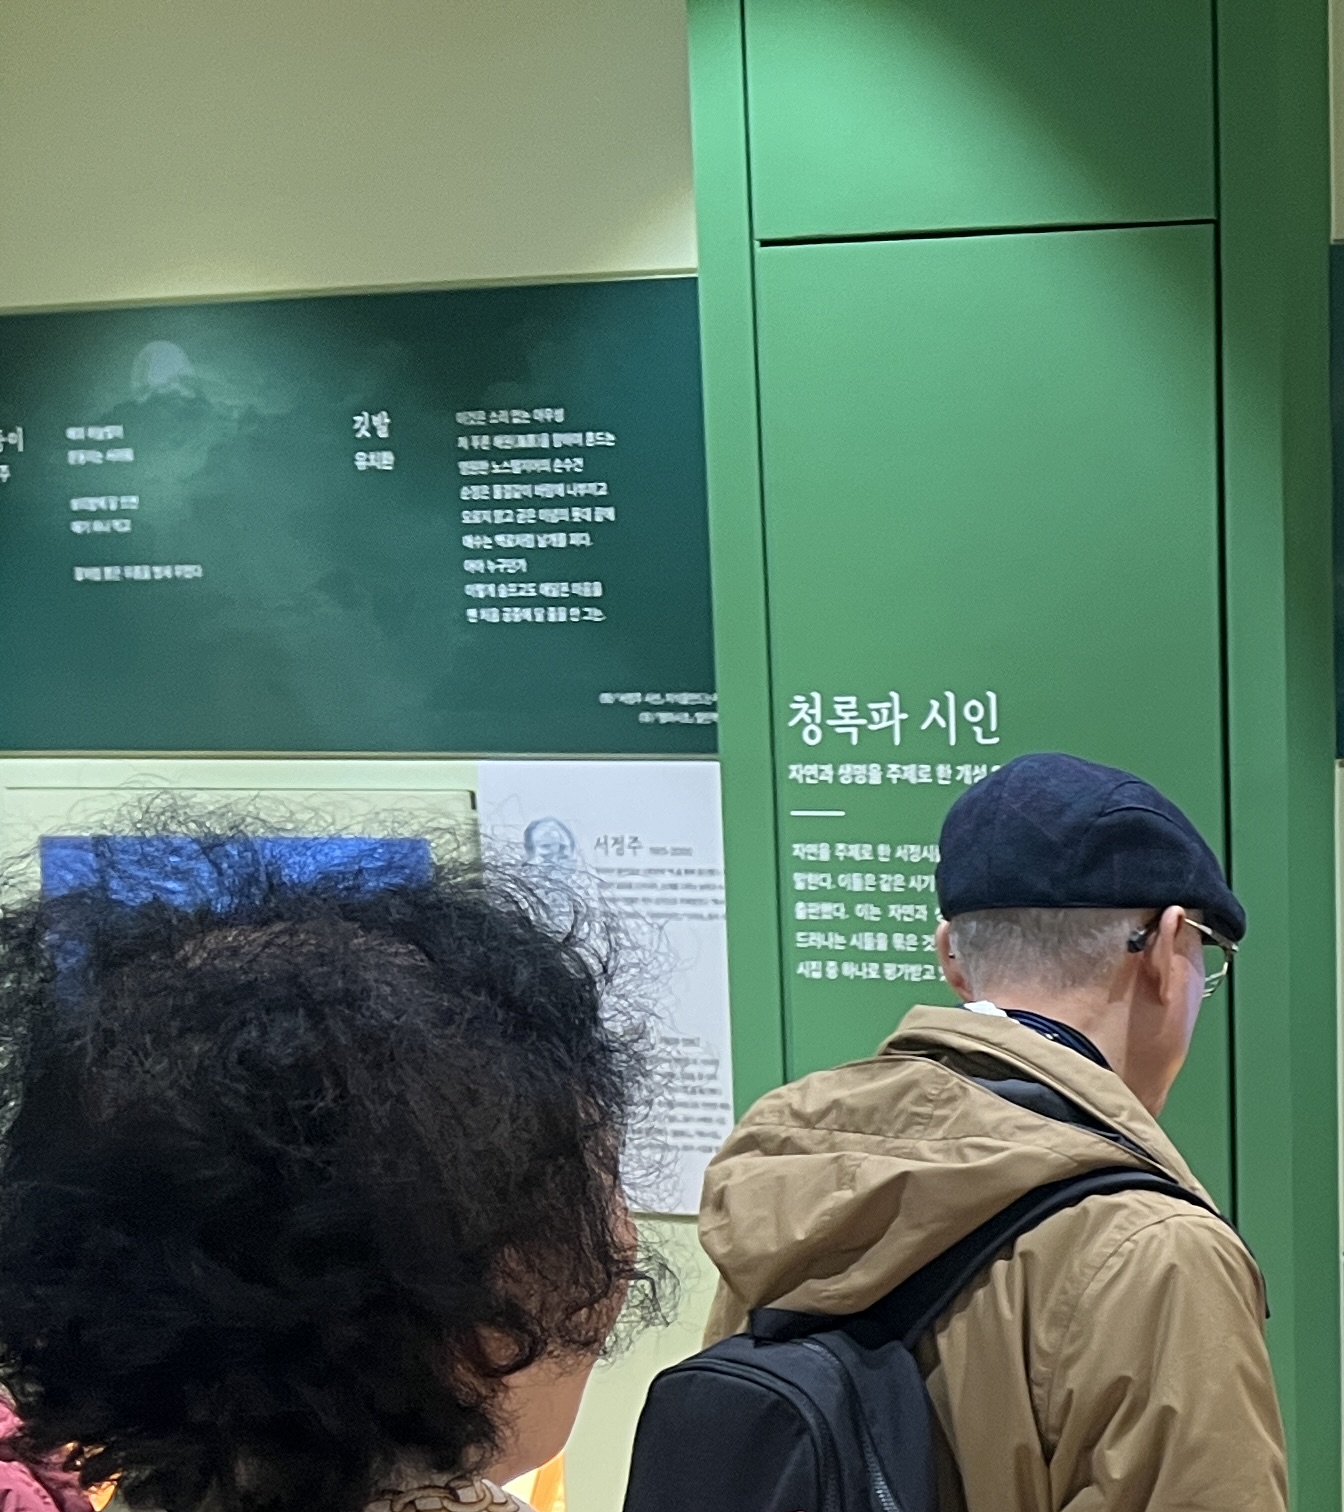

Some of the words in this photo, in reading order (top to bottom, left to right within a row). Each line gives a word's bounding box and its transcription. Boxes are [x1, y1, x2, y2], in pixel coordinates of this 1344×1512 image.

[788, 691, 908, 745] 청록파
[921, 691, 999, 745] 시인
[594, 835, 643, 856] 서정주
